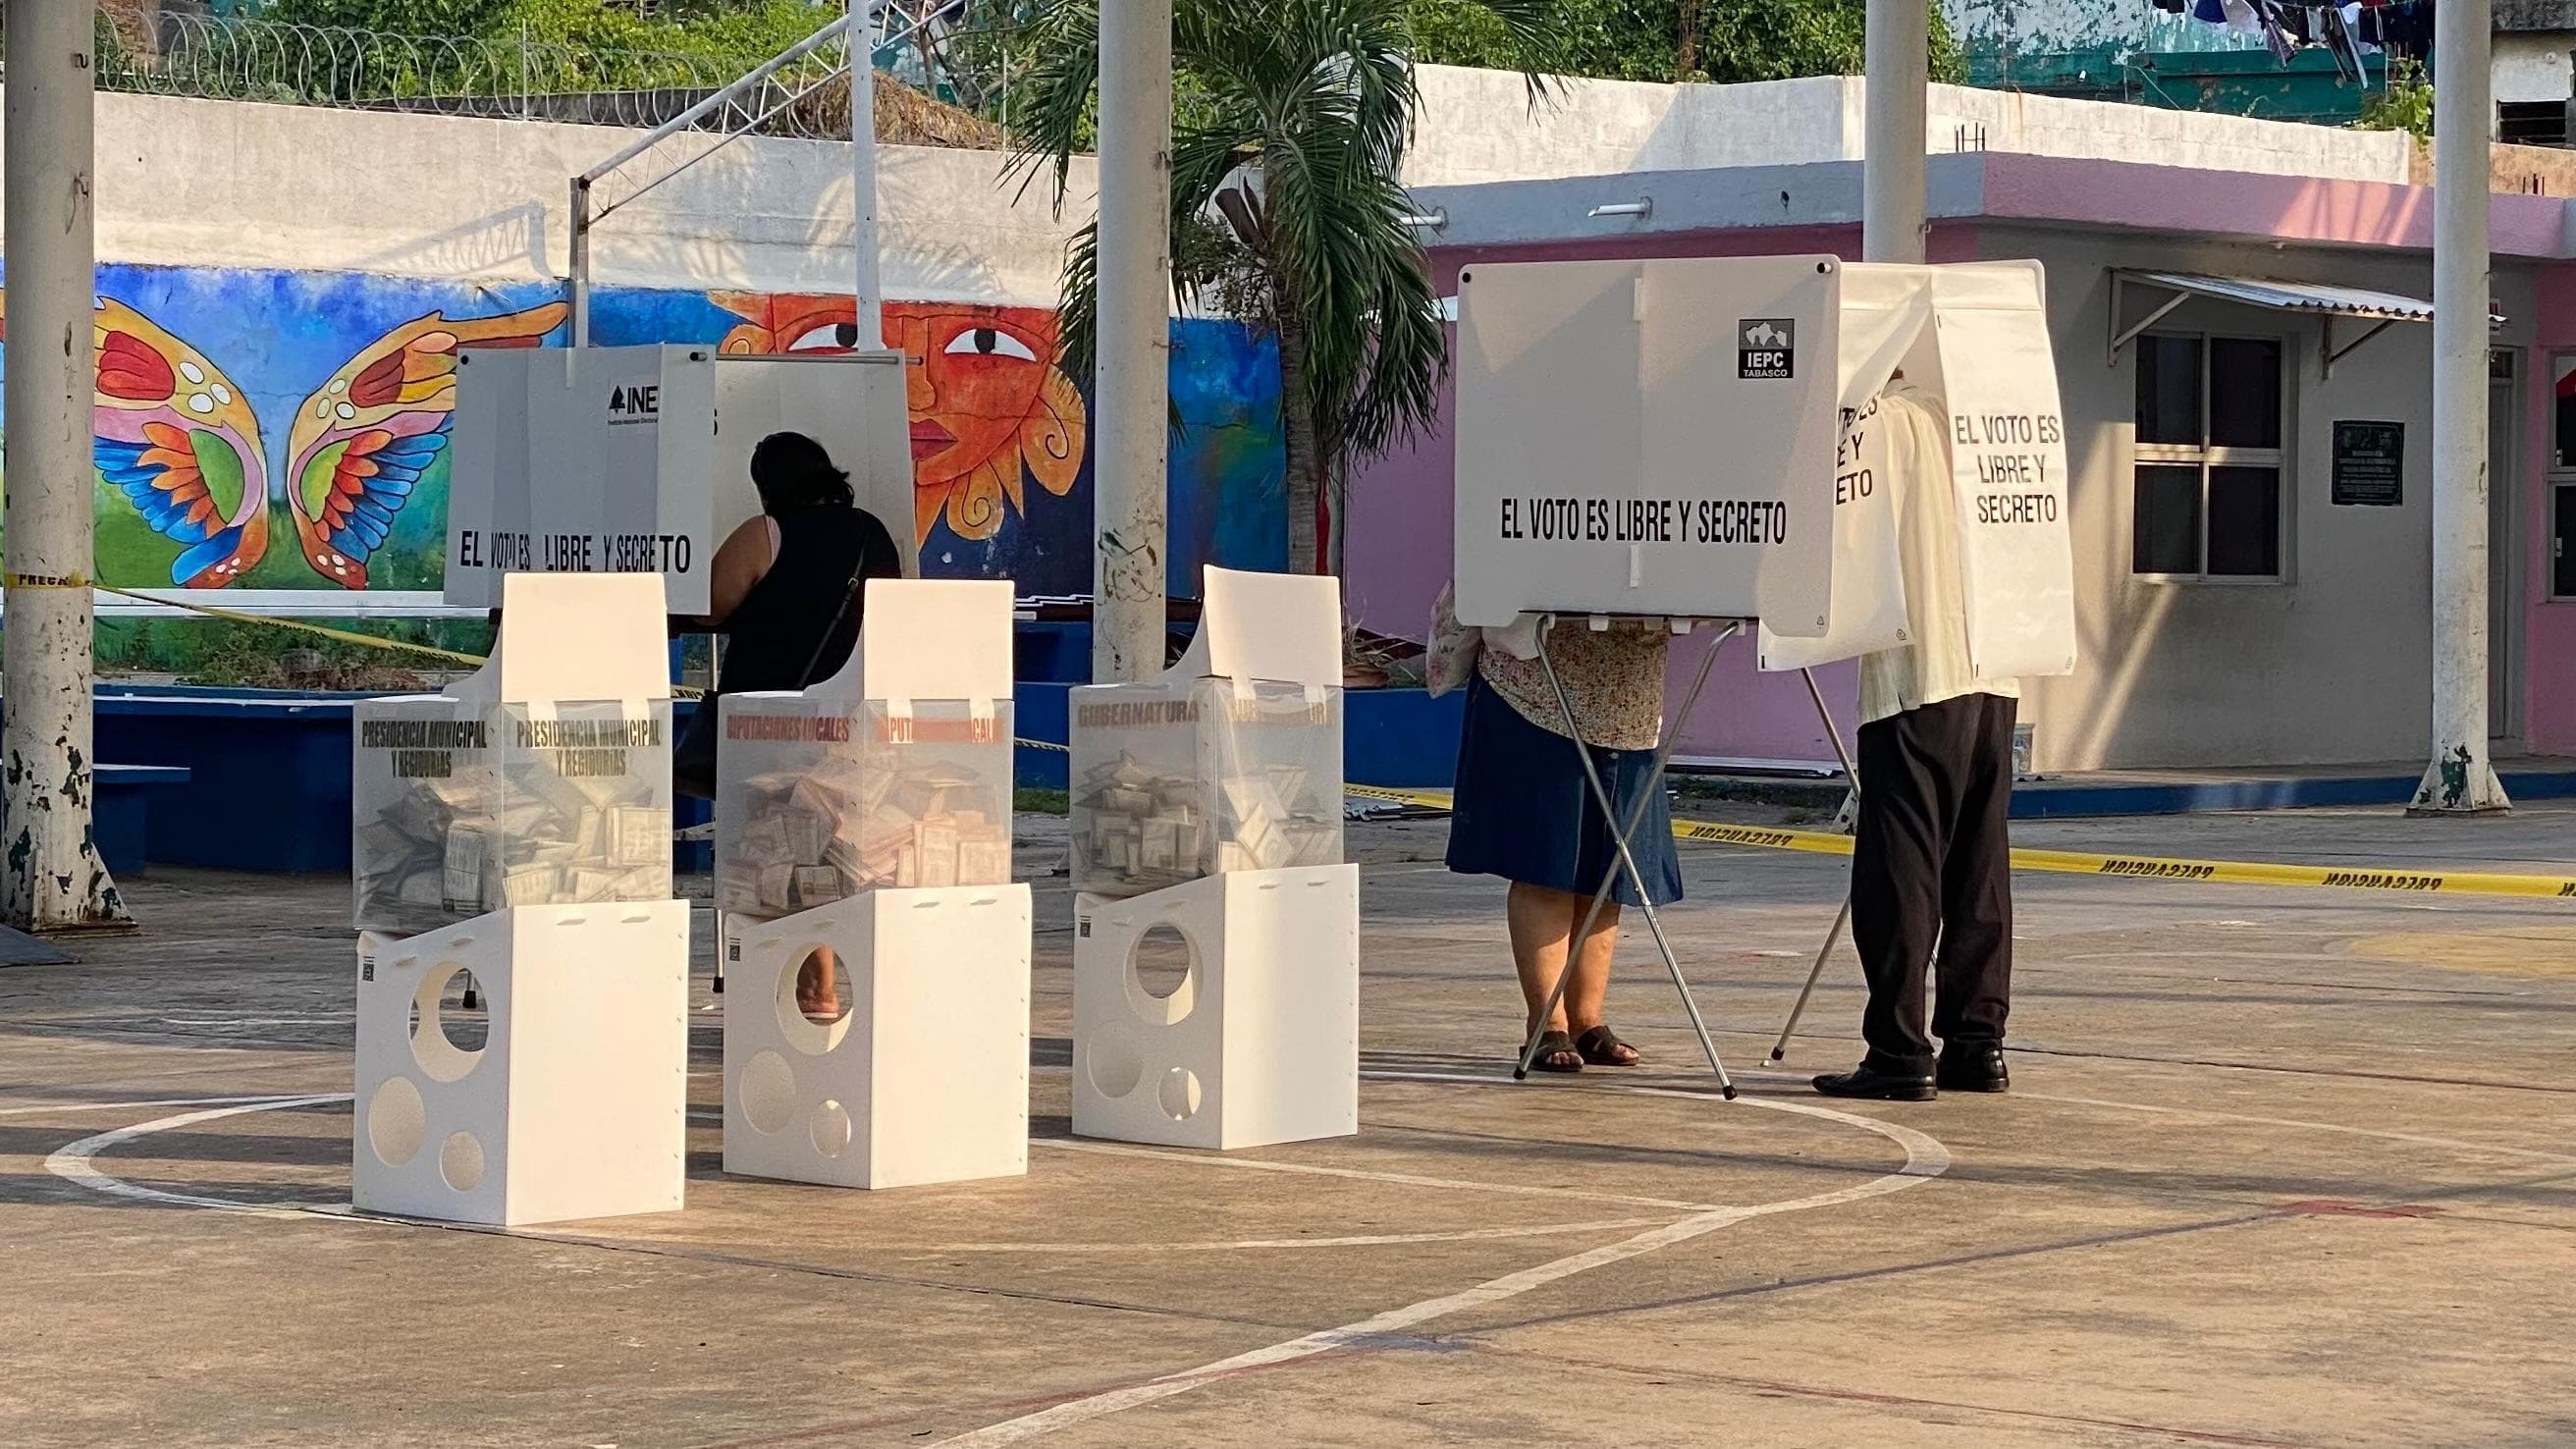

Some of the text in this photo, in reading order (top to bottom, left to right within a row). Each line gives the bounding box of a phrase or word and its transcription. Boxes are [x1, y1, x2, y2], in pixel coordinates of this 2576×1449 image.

[1743, 369, 1788, 378] TABASCO
[1747, 351, 1784, 368] IEPC
[626, 385, 659, 414] INE
[1955, 415, 2061, 445] EL VOTO ES
[1851, 431, 1864, 461] Y
[1977, 455, 2047, 484] LIBRE Y
[1501, 498, 1787, 545] EL VOTO ES LIBRE Y SECRETO
[1976, 494, 2057, 524] SECRETO
[459, 530, 484, 567] EL
[518, 533, 530, 570] ES
[545, 534, 592, 572] LIBRE
[603, 534, 612, 572] Y
[616, 534, 691, 573] SECRETO
[1078, 700, 1200, 727] GUBERNATURA
[361, 720, 487, 749] PRESIDENCIA MUNICIPAL
[516, 719, 661, 748] PRESIDENCIA MUNICIPAL
[391, 750, 398, 778] Y
[556, 749, 564, 778] Y
